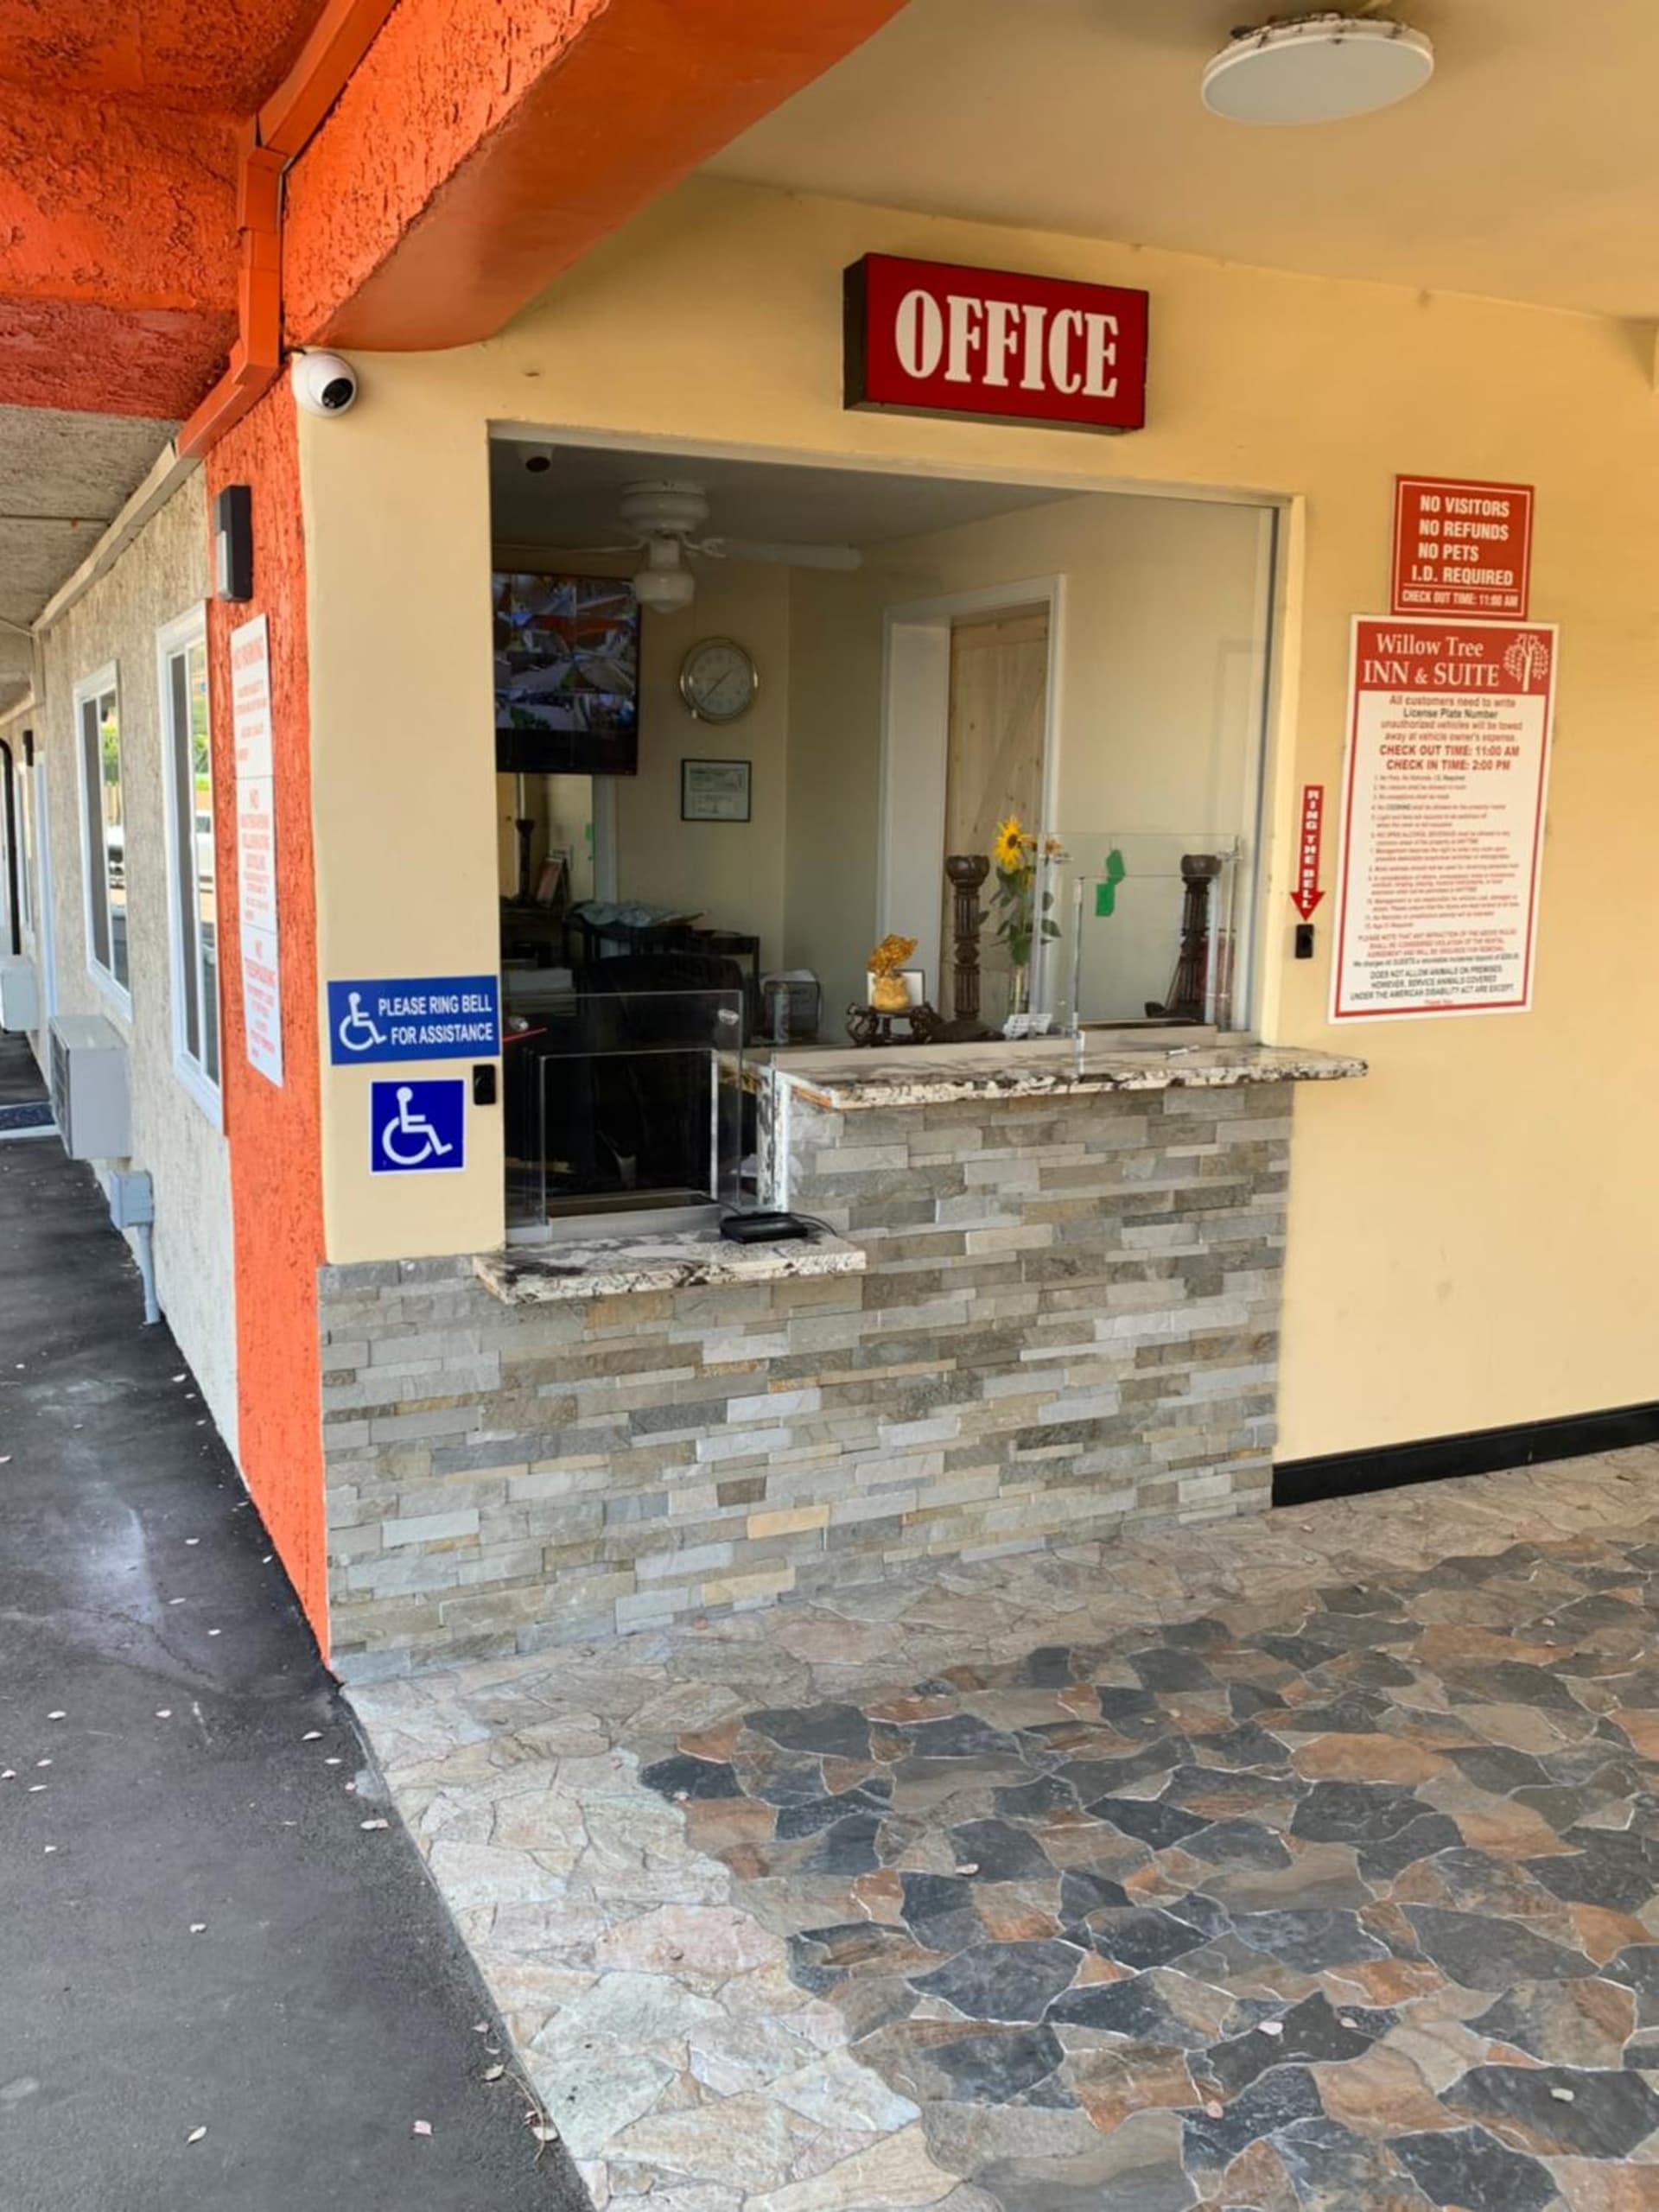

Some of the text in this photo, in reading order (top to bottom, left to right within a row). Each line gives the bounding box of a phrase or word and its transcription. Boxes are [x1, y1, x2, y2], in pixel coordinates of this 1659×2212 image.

[894, 289, 1119, 398] OFFICE
[1420, 494, 1510, 518] NO VISITORS
[1419, 518, 1510, 541] NO REFUNDS
[1418, 542, 1479, 562] NO PETS
[1411, 564, 1514, 586] I.D. REQUIRED
[1402, 589, 1433, 602] CHECK
[1433, 591, 1452, 604] OUT
[1453, 592, 1478, 605] TIME:
[1504, 594, 1519, 607] AM
[1376, 632, 1484, 657] Willow Tree
[1363, 659, 1500, 687] INN & SUITE
[1389, 695, 1516, 708] All customers need to write
[1403, 708, 1498, 719] License Plate Number
[1379, 745, 1521, 757] CHECK OUT TIME: 11:00 AM
[1386, 760, 1511, 771] CHECK IN TIME: 2:00 PM
[1303, 790, 1319, 908] RING THE BELL
[378, 995, 493, 1017] PLEASE RING BELL
[391, 1022, 493, 1046] FOR ASSISTANCE
